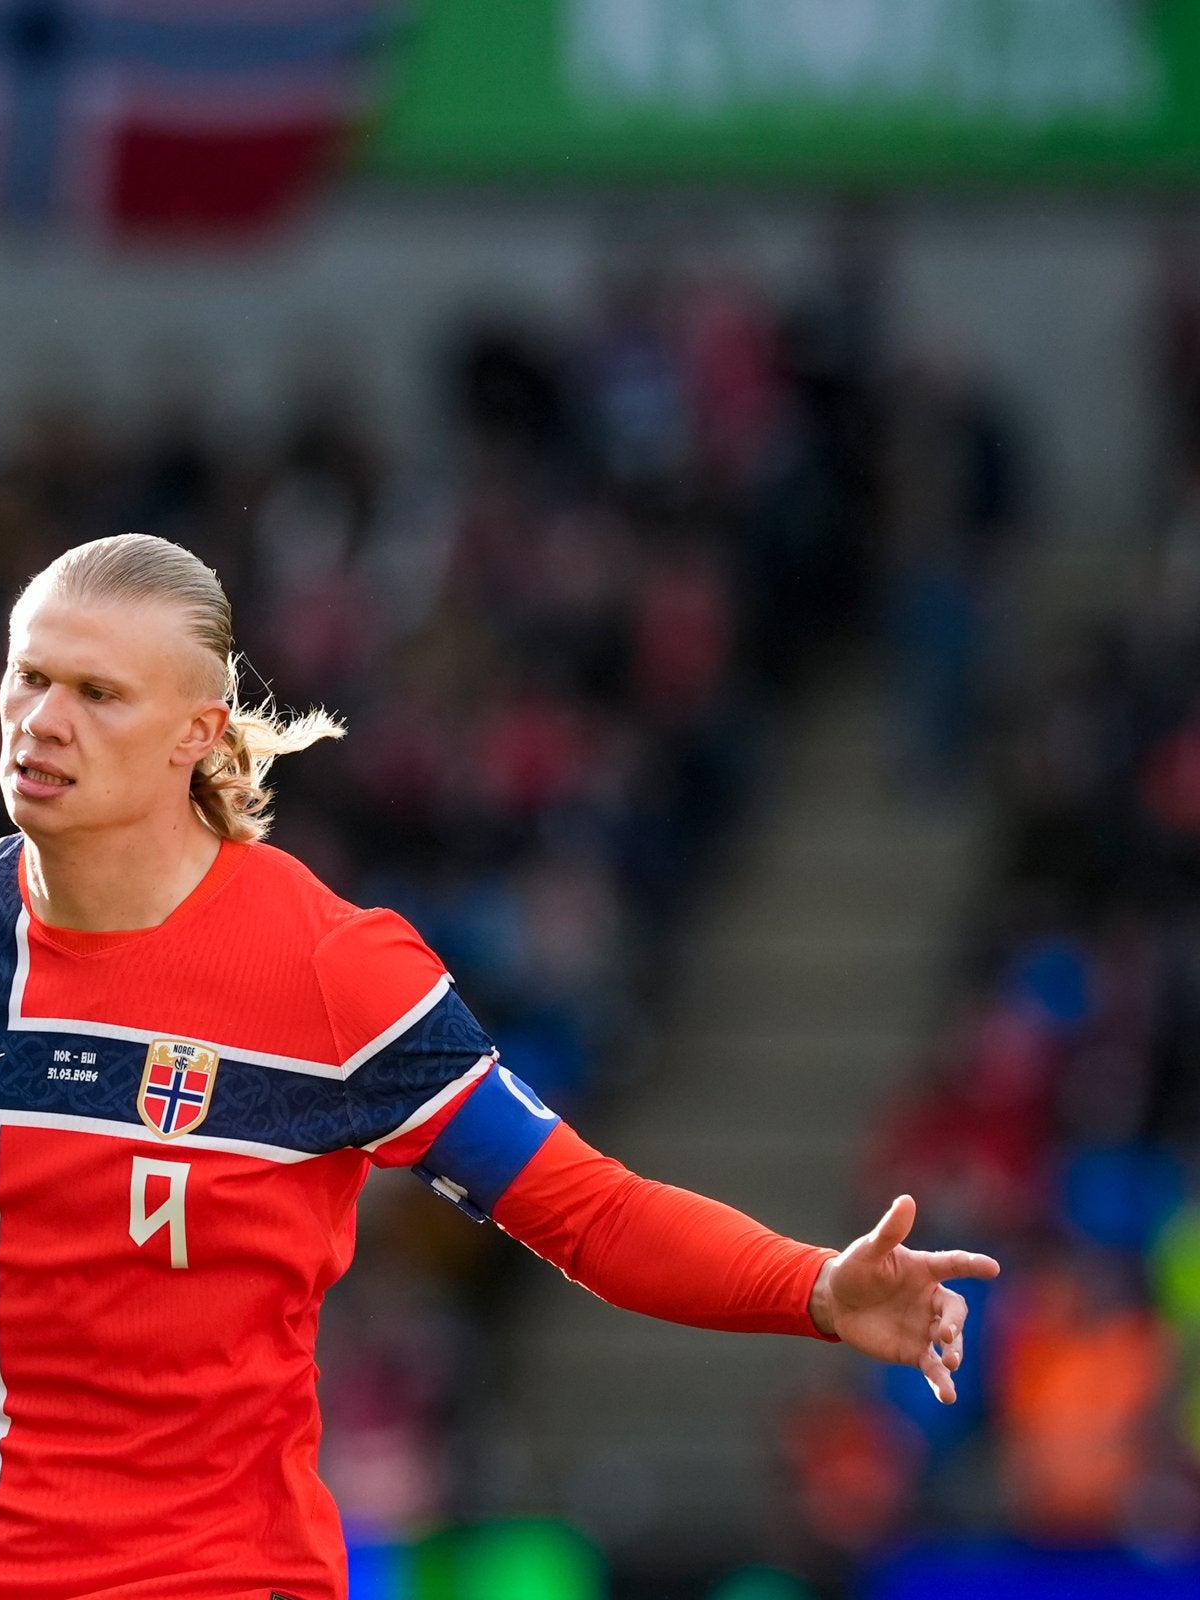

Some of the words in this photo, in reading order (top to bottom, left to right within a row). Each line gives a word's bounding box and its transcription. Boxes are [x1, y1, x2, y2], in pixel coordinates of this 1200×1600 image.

[53, 1050, 72, 1062] NOR
[80, 1051, 97, 1064] SUI
[173, 1044, 196, 1057] NORGE
[47, 1067, 100, 1083] 31.03.2026
[129, 1155, 191, 1269] 9
